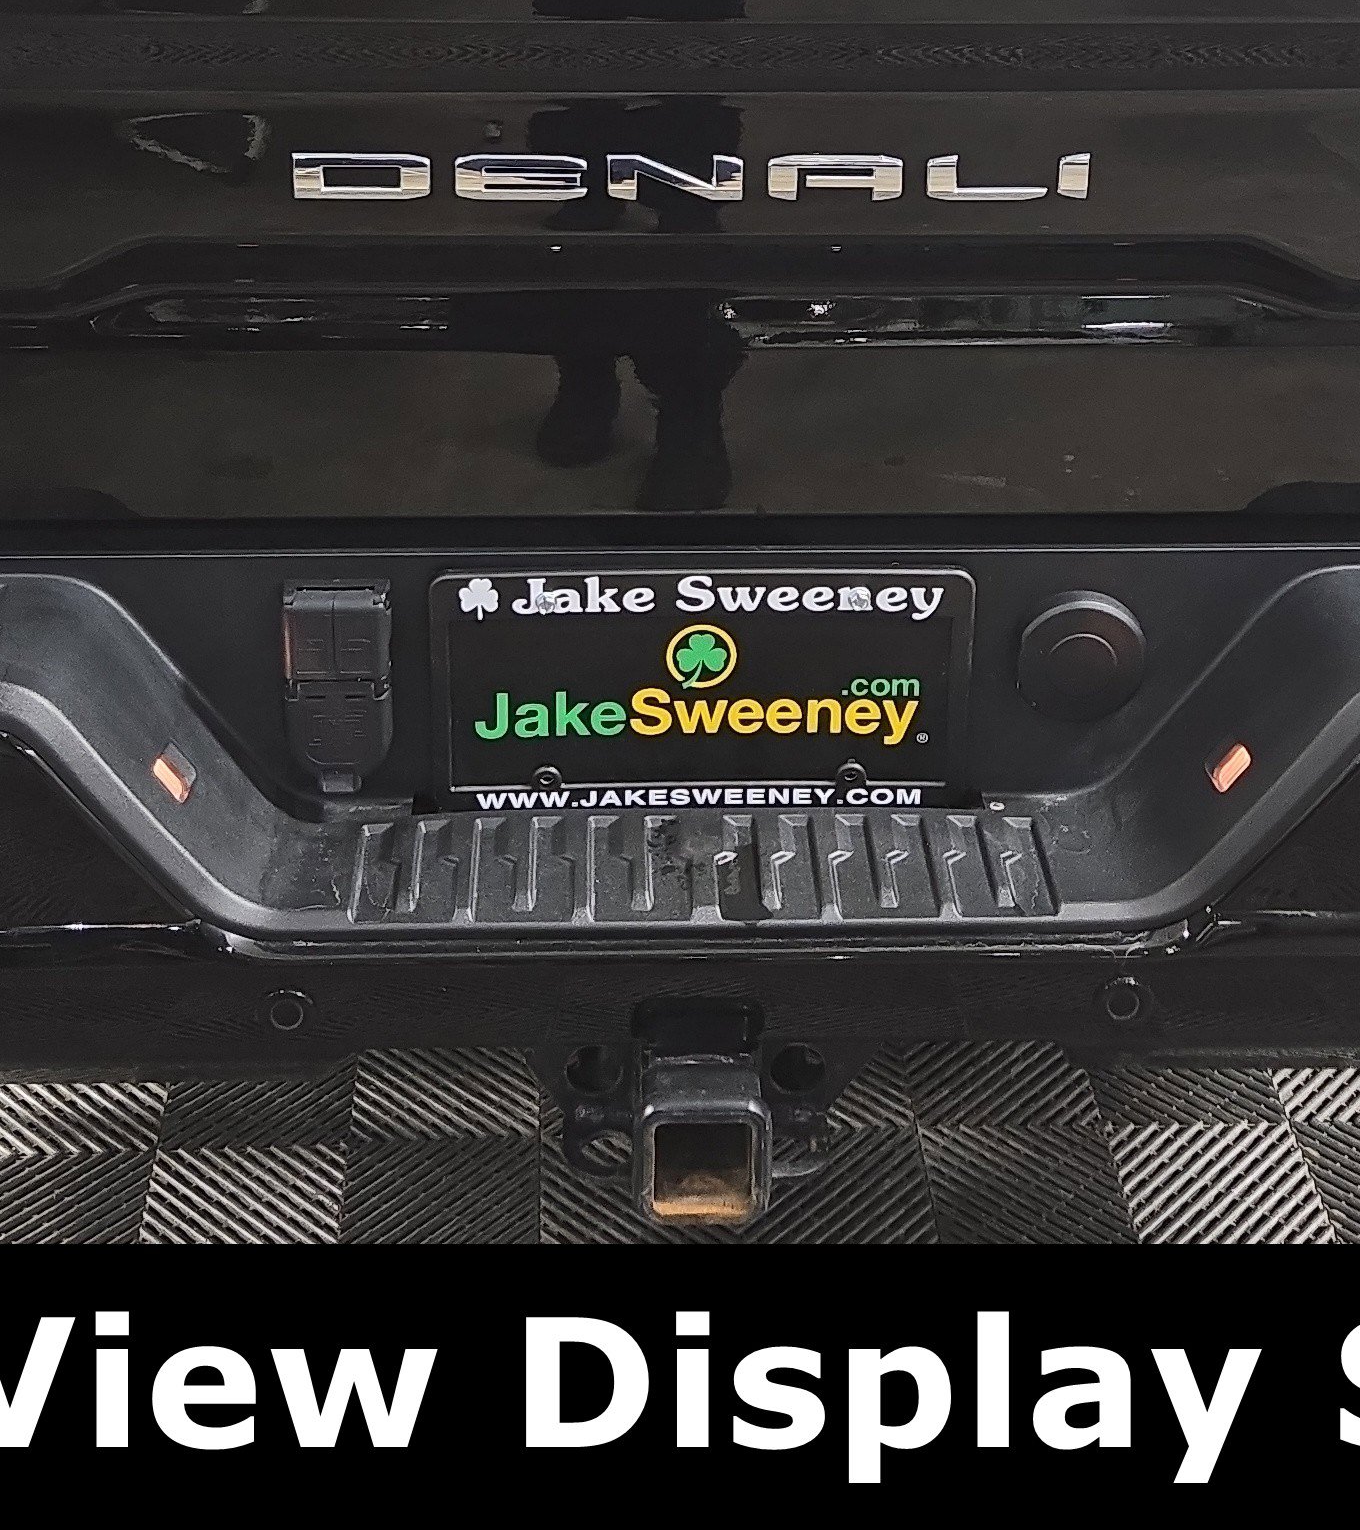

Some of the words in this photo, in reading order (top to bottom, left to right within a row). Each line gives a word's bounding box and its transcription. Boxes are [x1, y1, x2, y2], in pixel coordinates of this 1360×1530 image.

[290, 152, 1093, 202] DENALI
[512, 576, 656, 616] Jake
[675, 575, 945, 621] Sweeney
[476, 788, 923, 811] WWW.JAKESWEENEY.COM
